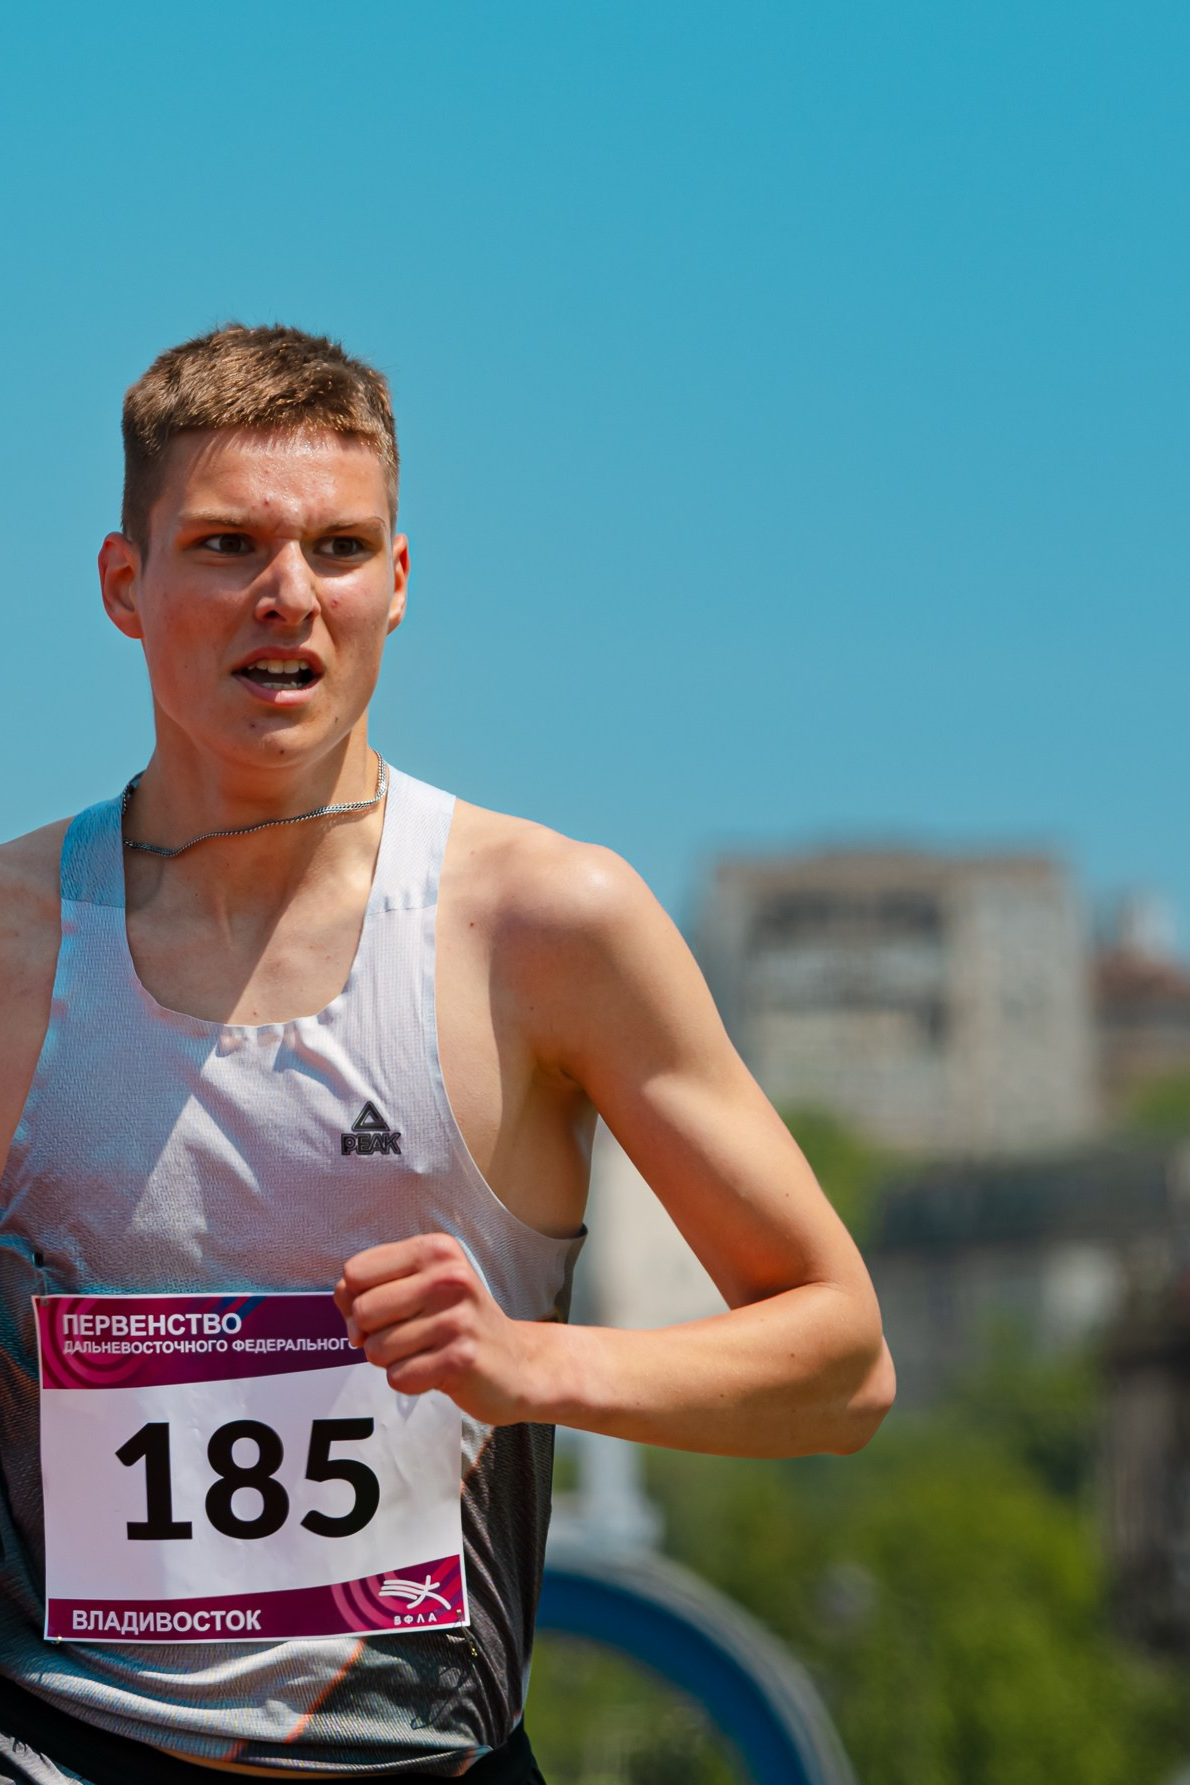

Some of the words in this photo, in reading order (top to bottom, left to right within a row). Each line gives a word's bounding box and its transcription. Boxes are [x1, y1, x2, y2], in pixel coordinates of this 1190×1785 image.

[341, 1132, 402, 1155] PEAK
[63, 1313, 242, 1336] ПЕРВЕНСТВО
[63, 1339, 228, 1355] ДАЛЬНЕВОСТОЧНОГО
[115, 1417, 380, 1540] 185
[72, 1609, 261, 1634] ВЛАДИВОСТОК
[393, 1612, 437, 1626] ВФЛА
